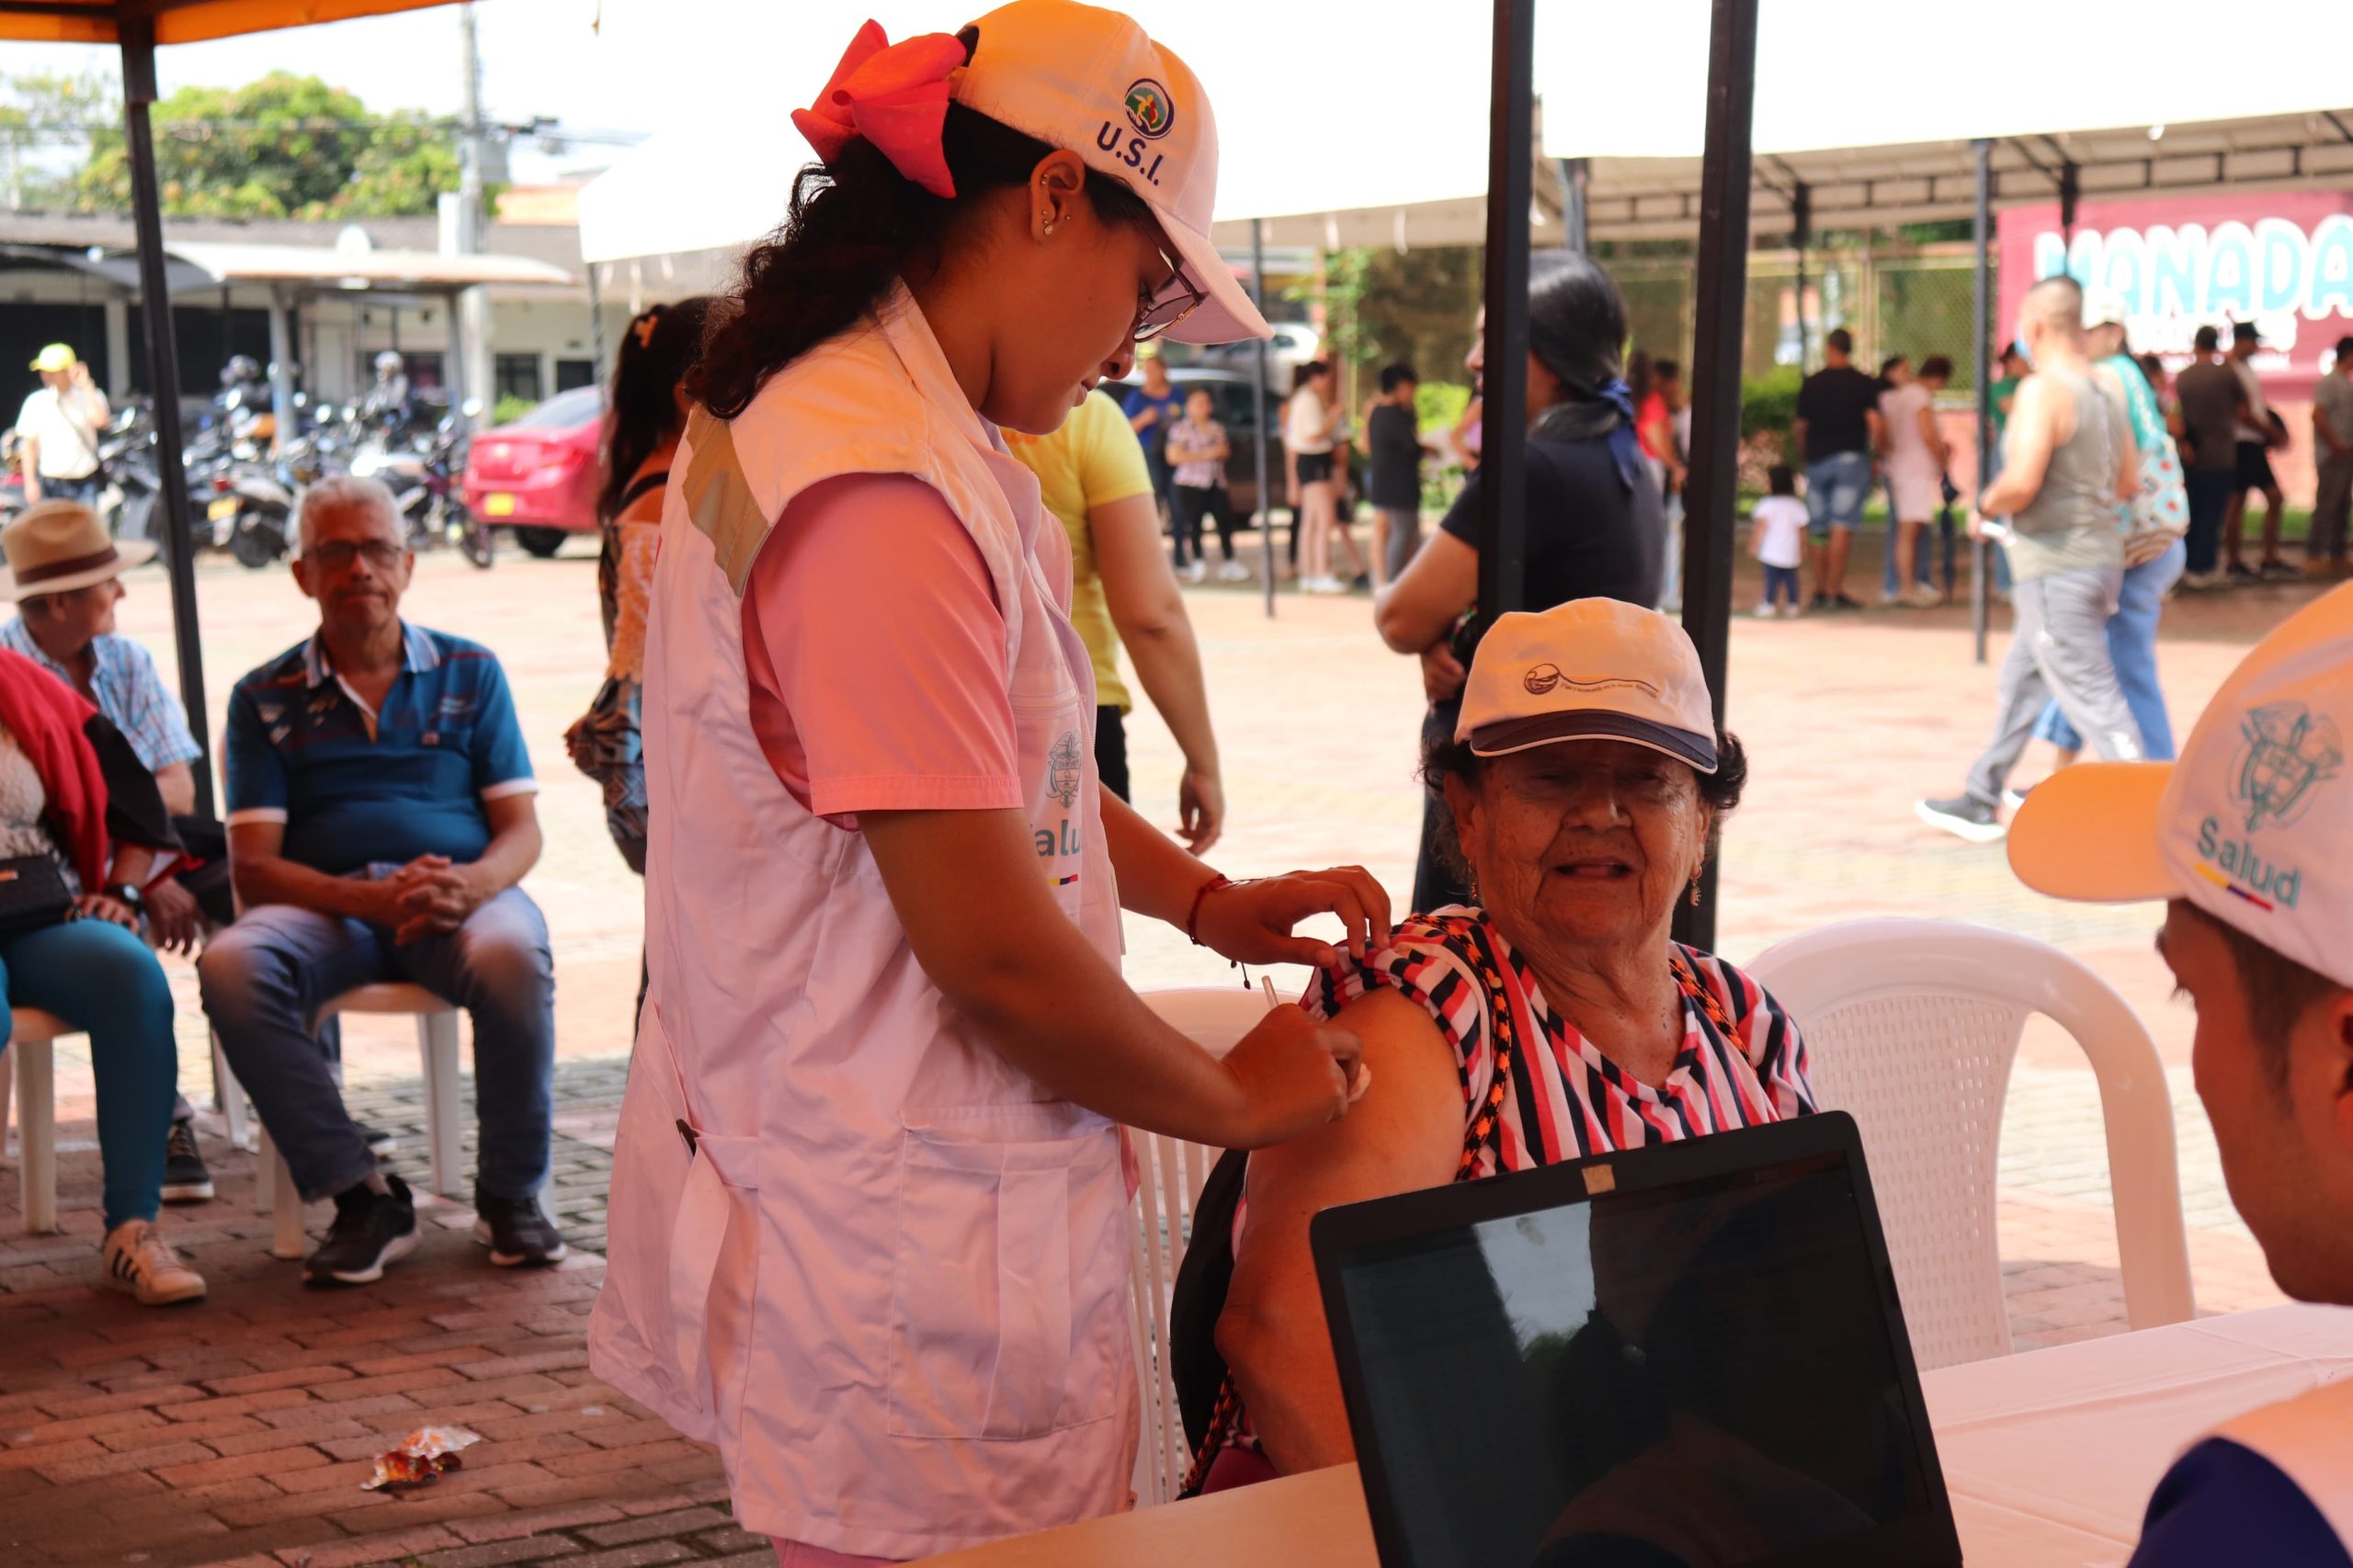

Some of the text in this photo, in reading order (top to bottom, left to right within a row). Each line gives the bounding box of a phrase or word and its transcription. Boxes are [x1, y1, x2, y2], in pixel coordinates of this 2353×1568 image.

[1097, 120, 1164, 187] U.S.I.
[1034, 819, 1081, 857] alu
[2197, 815, 2302, 910] Salud
